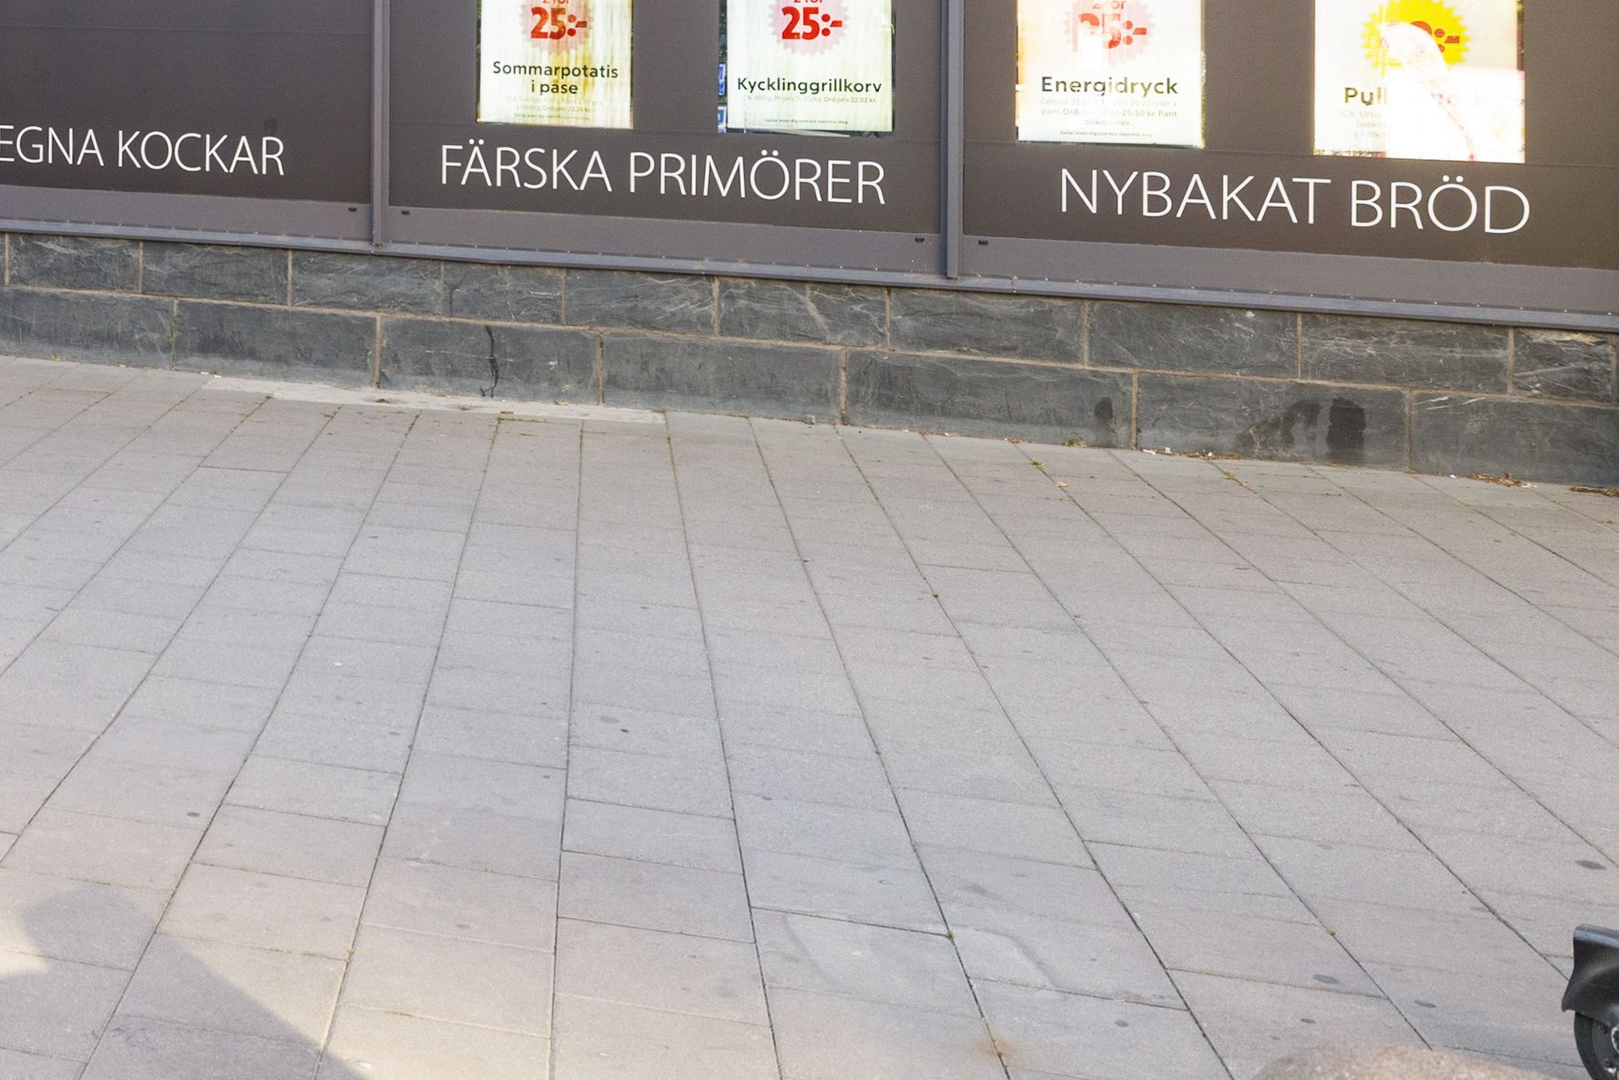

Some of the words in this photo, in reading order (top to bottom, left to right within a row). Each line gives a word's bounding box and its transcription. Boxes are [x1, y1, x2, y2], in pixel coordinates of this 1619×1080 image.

[531, 6, 588, 40] 25:-
[782, 6, 843, 40] 25:-
[493, 61, 619, 79] Sommarpotatis
[531, 80, 535, 92] i
[540, 79, 578, 95] påse
[737, 77, 882, 94] Kycklinggrillkorv
[1041, 76, 1178, 97] Energidryck
[118, 129, 285, 176] KOCKAR
[441, 138, 612, 192] FÄRSKA
[629, 149, 886, 204] PRIMÖRER
[1061, 168, 1331, 224] NYBAKAT
[1351, 174, 1530, 234] BRÖD
